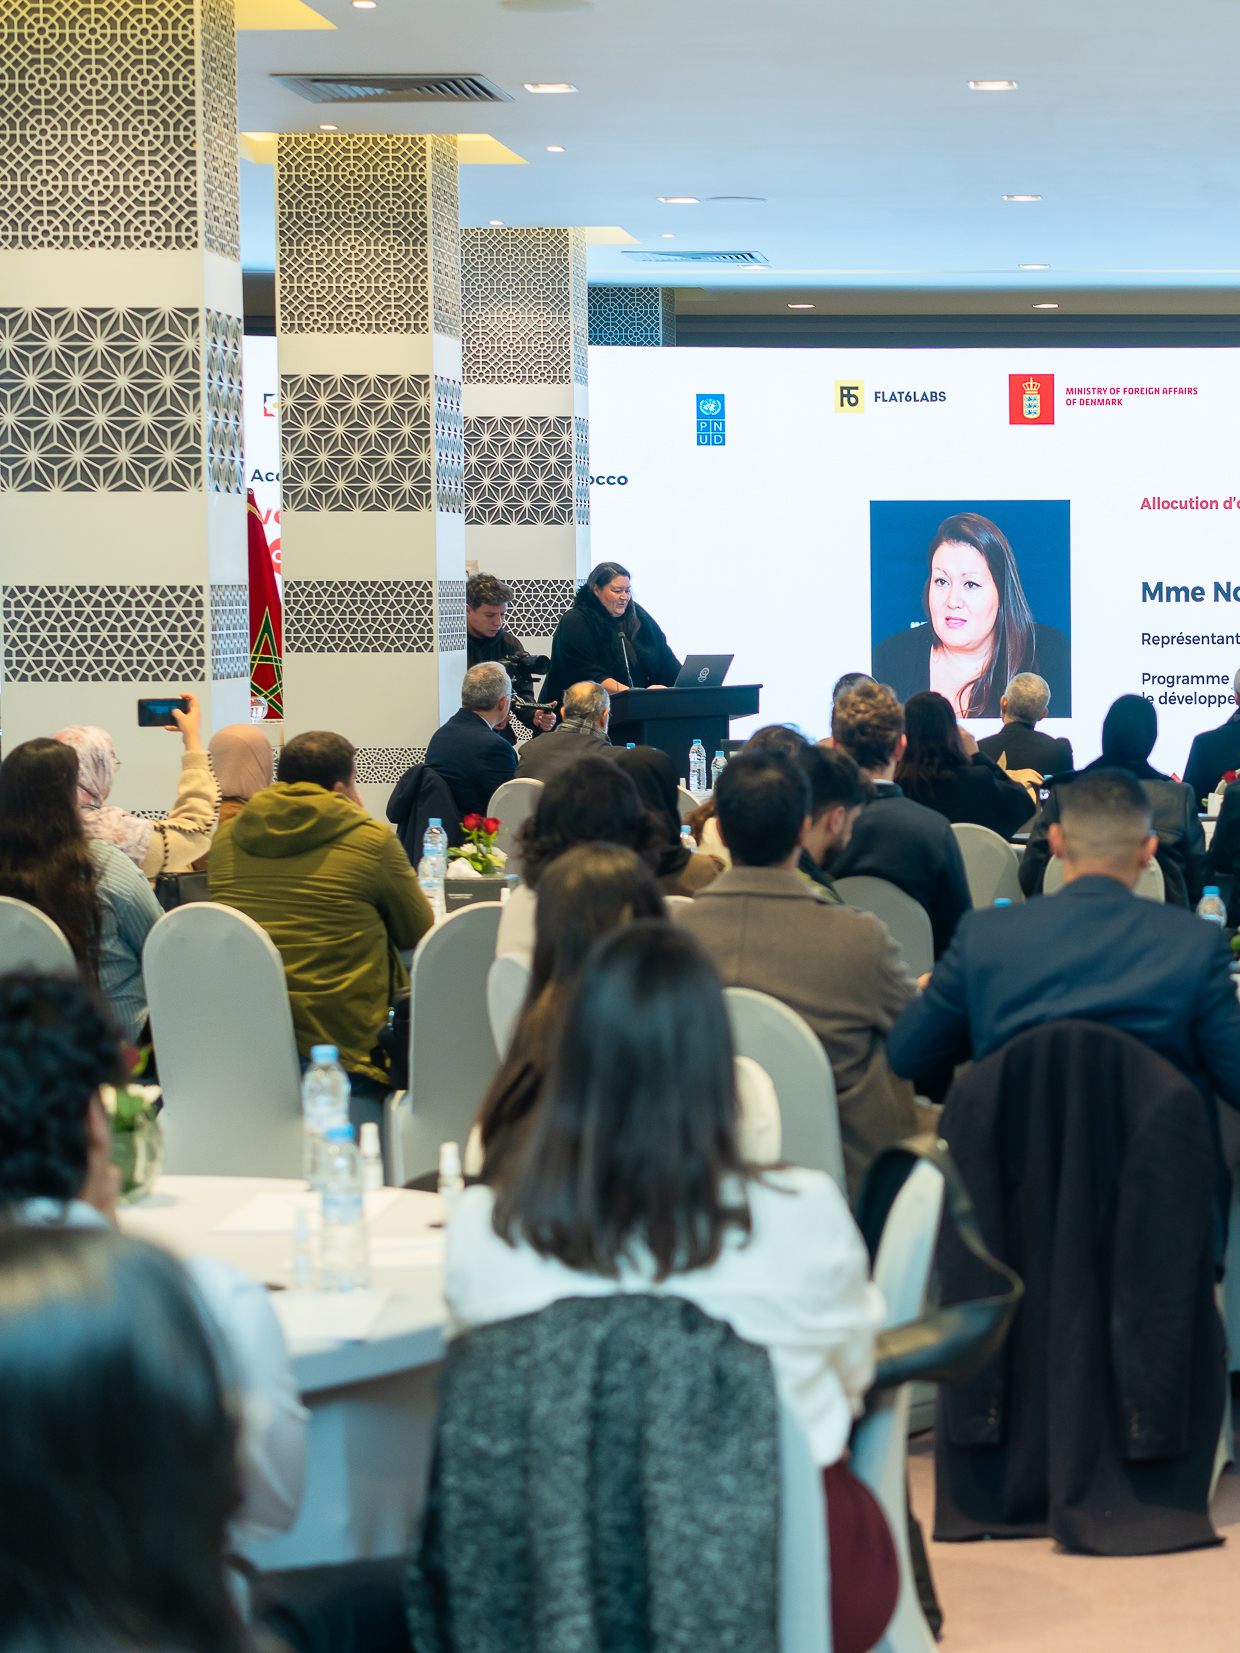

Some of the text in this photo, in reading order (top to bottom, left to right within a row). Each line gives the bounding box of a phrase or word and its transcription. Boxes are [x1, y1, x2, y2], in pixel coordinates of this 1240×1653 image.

[874, 391, 946, 402] FLAT6LABS
[1065, 387, 1198, 395] MINISTRY OF FOREIGN AFFAIRS
[1065, 398, 1123, 406] OF DENMARK
[1140, 496, 1219, 510] Allocution
[1141, 581, 1206, 602] Mme
[1142, 672, 1230, 688] Programme
